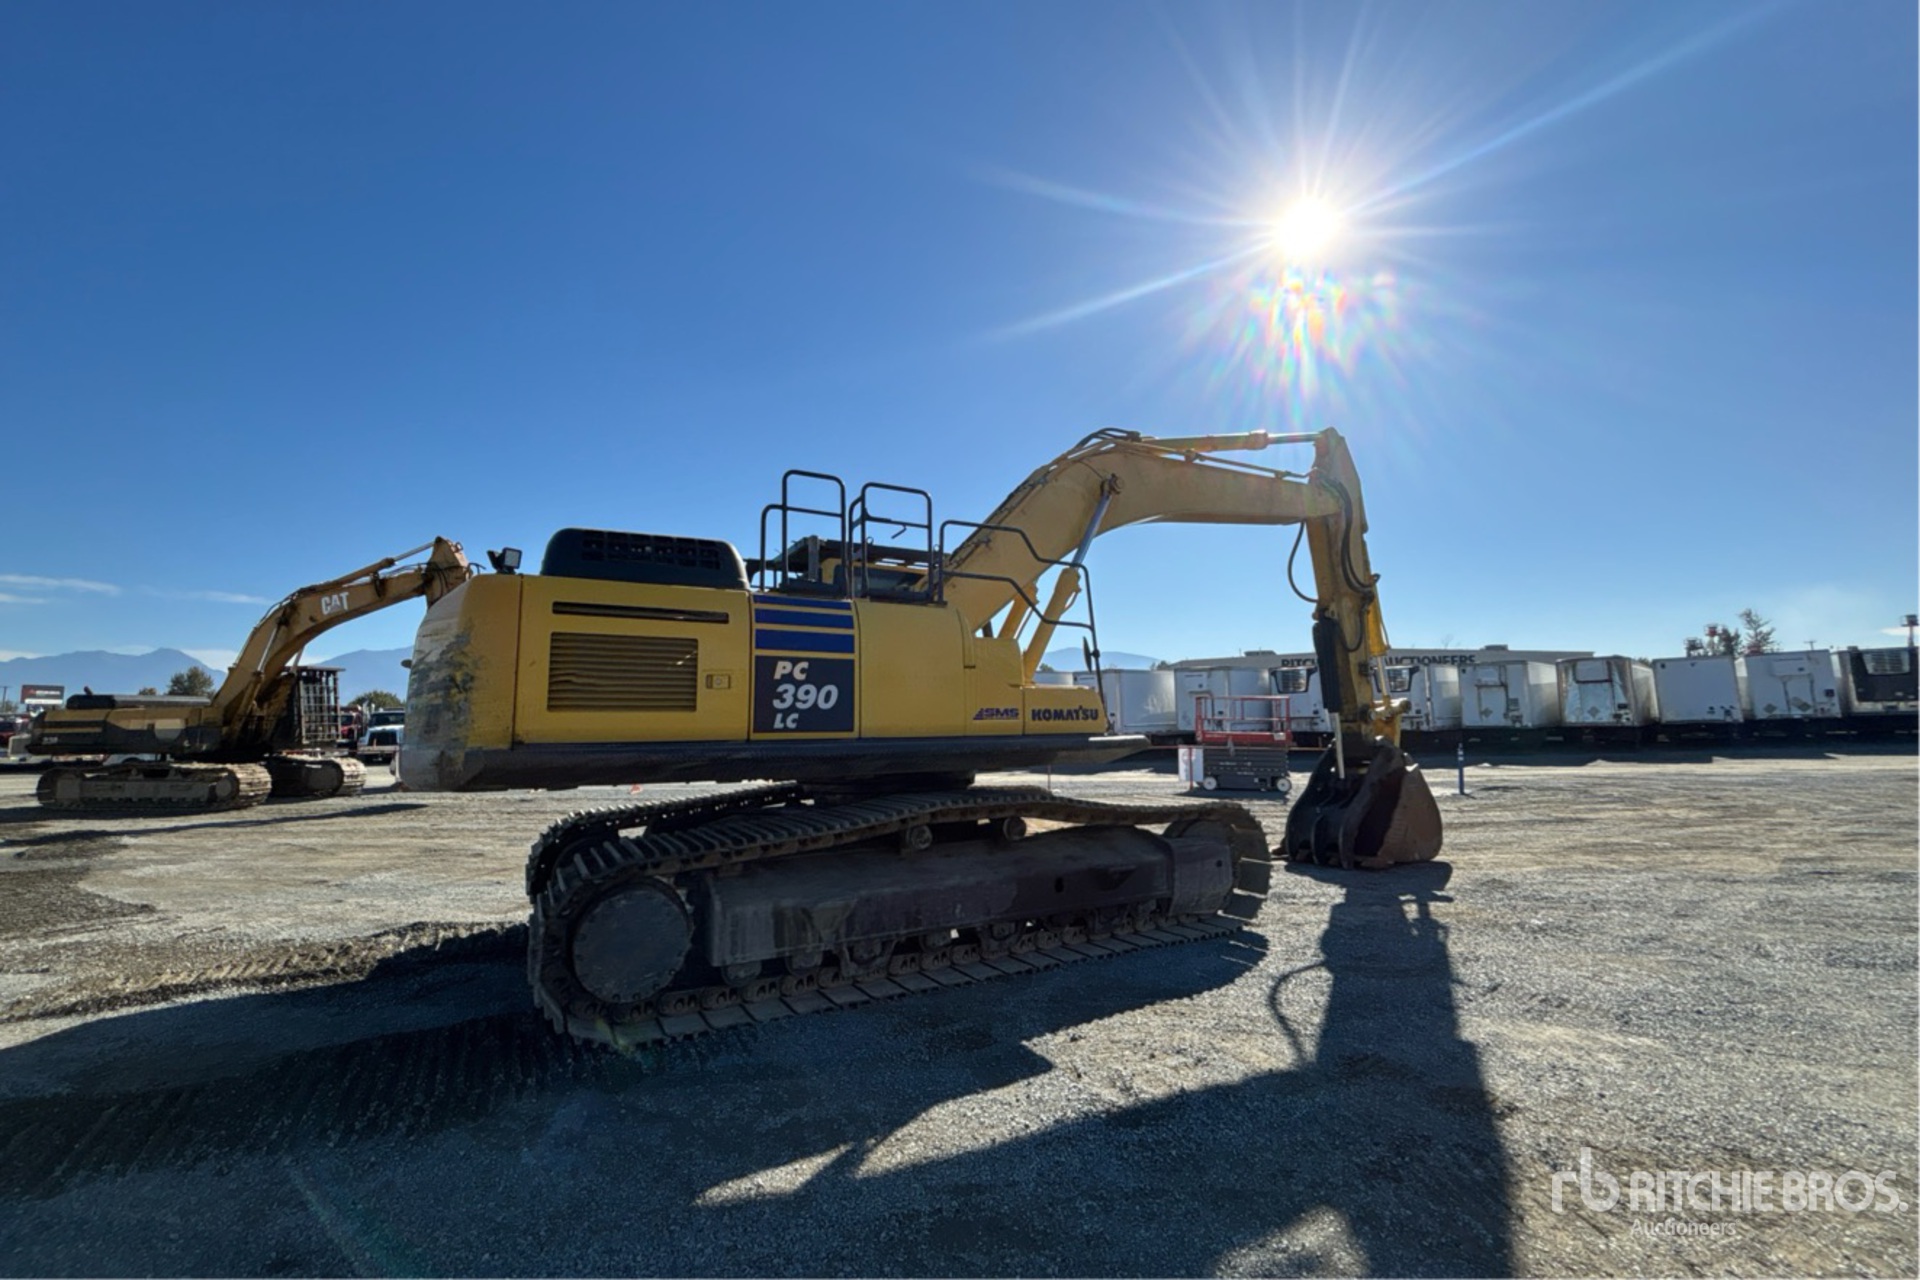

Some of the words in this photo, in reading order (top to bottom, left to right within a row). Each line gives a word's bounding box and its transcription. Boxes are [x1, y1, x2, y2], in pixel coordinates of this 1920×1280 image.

[321, 591, 349, 615] CAT
[773, 661, 809, 680] PC
[772, 683, 839, 710] 390
[773, 712, 799, 729] LC
[983, 707, 1019, 718] SMS
[1031, 705, 1099, 721] KOMATSU
